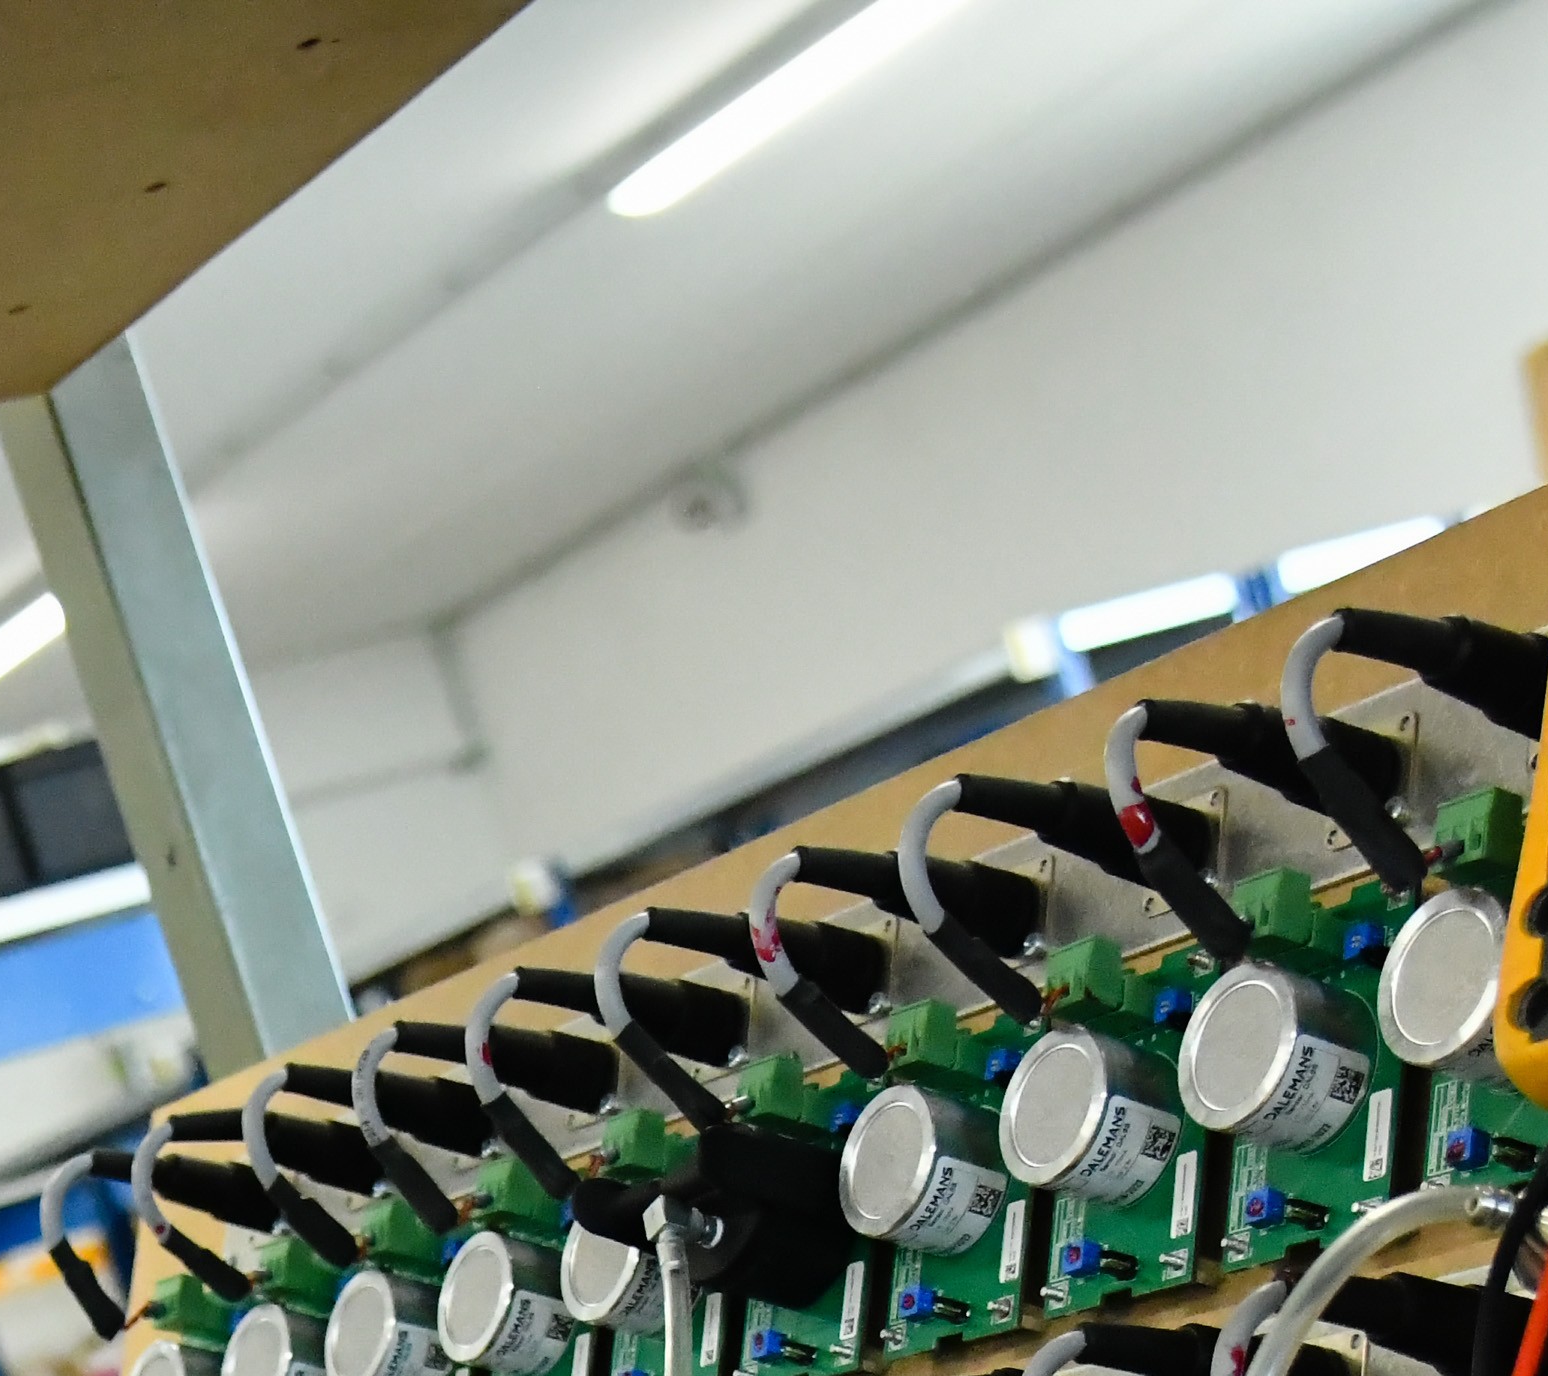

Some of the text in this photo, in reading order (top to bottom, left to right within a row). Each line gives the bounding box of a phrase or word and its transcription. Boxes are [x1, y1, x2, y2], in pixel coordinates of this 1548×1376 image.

[1264, 1046, 1315, 1121] DALEMANS
[1079, 1106, 1126, 1178] DALEMANS
[909, 1166, 953, 1232] DALEMANS
